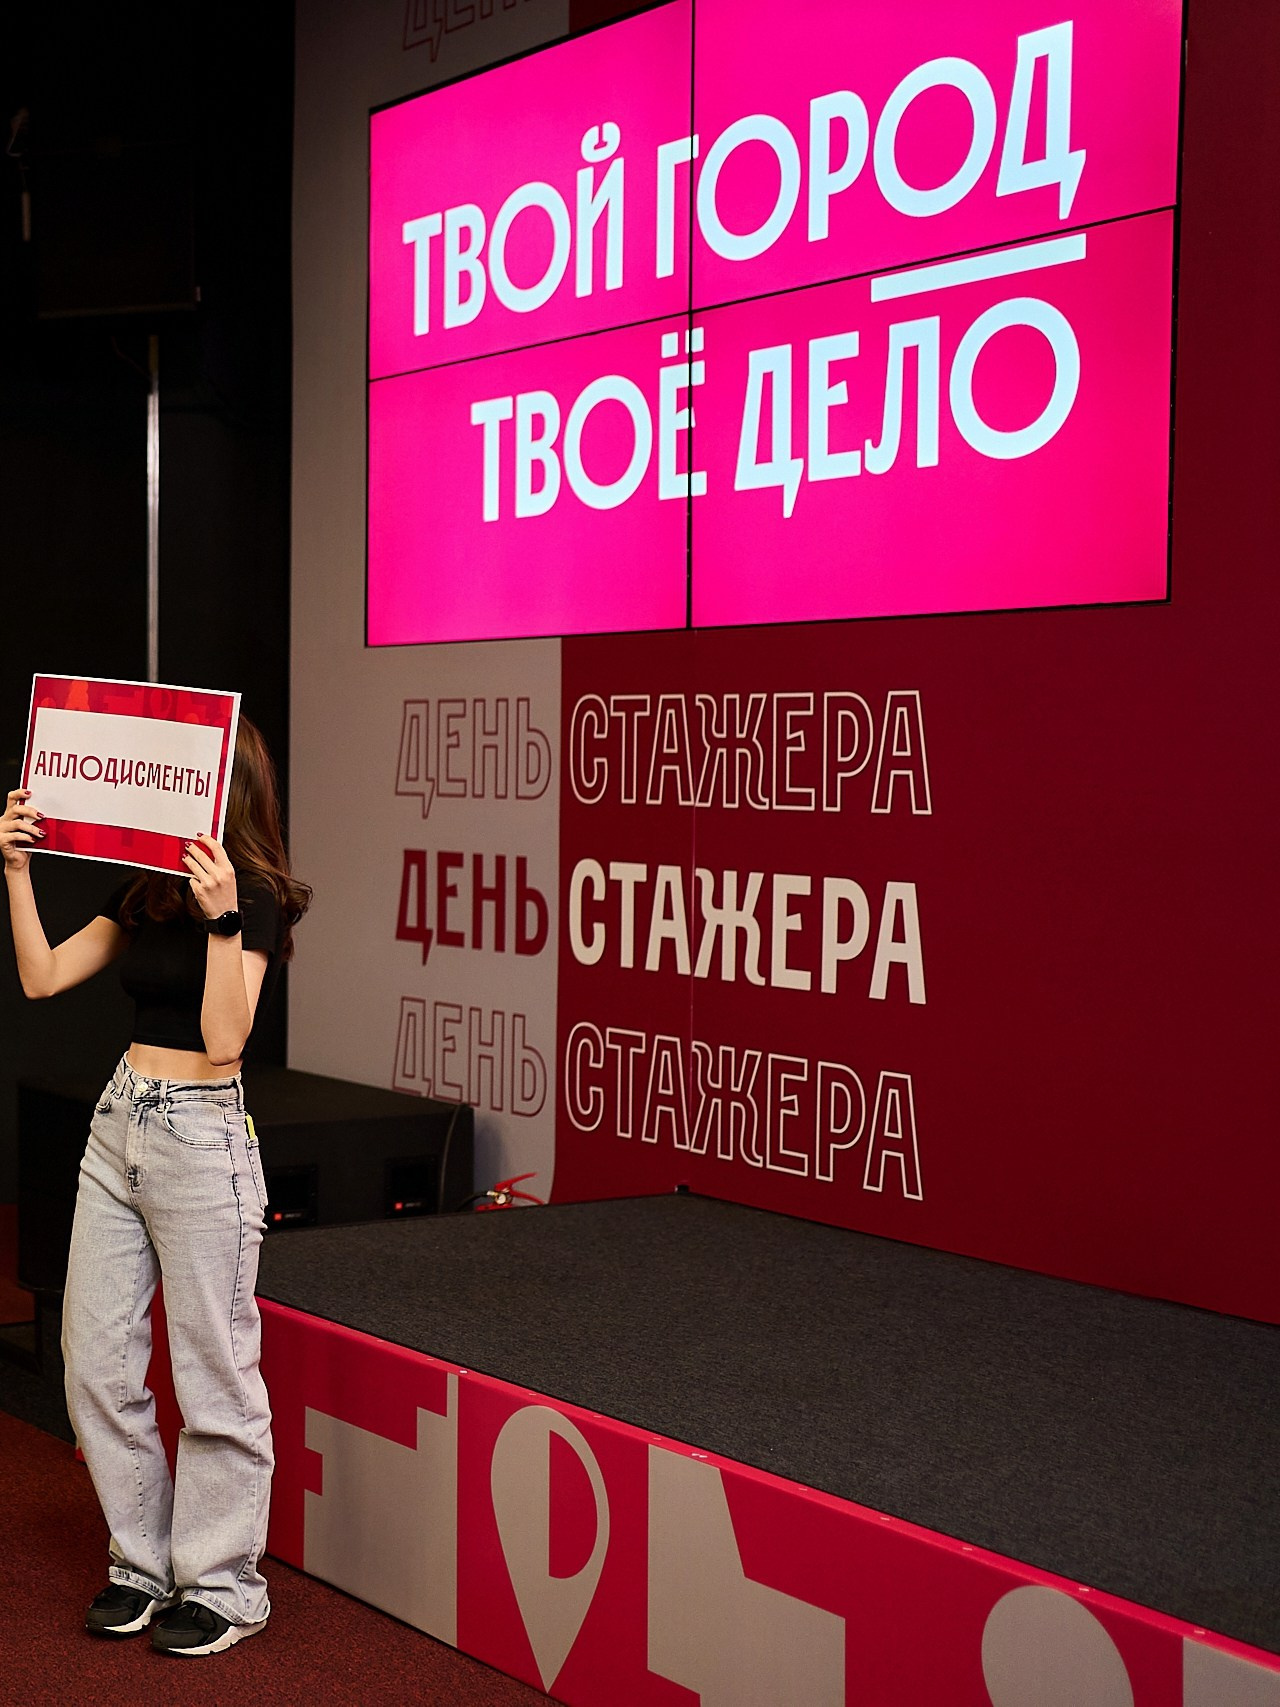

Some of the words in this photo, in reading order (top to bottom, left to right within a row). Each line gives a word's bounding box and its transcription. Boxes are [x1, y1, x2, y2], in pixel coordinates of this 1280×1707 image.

[402, 121, 624, 337] ТВОЙ
[656, 20, 1087, 279] ГОРОД
[470, 326, 707, 523] ТВОЁ
[733, 296, 1081, 519] ДЕЛО
[34, 750, 211, 798] АПЛОДИСМЕНТЫ
[395, 697, 552, 819] ДЕНЬ
[569, 690, 932, 815] СТАЖЕРА
[395, 848, 549, 966] ДЕНЬ
[568, 857, 927, 1005] СТАЖЕРА
[392, 996, 547, 1117] ДЕНЬ
[565, 1021, 923, 1201] СТАЖЕРА
